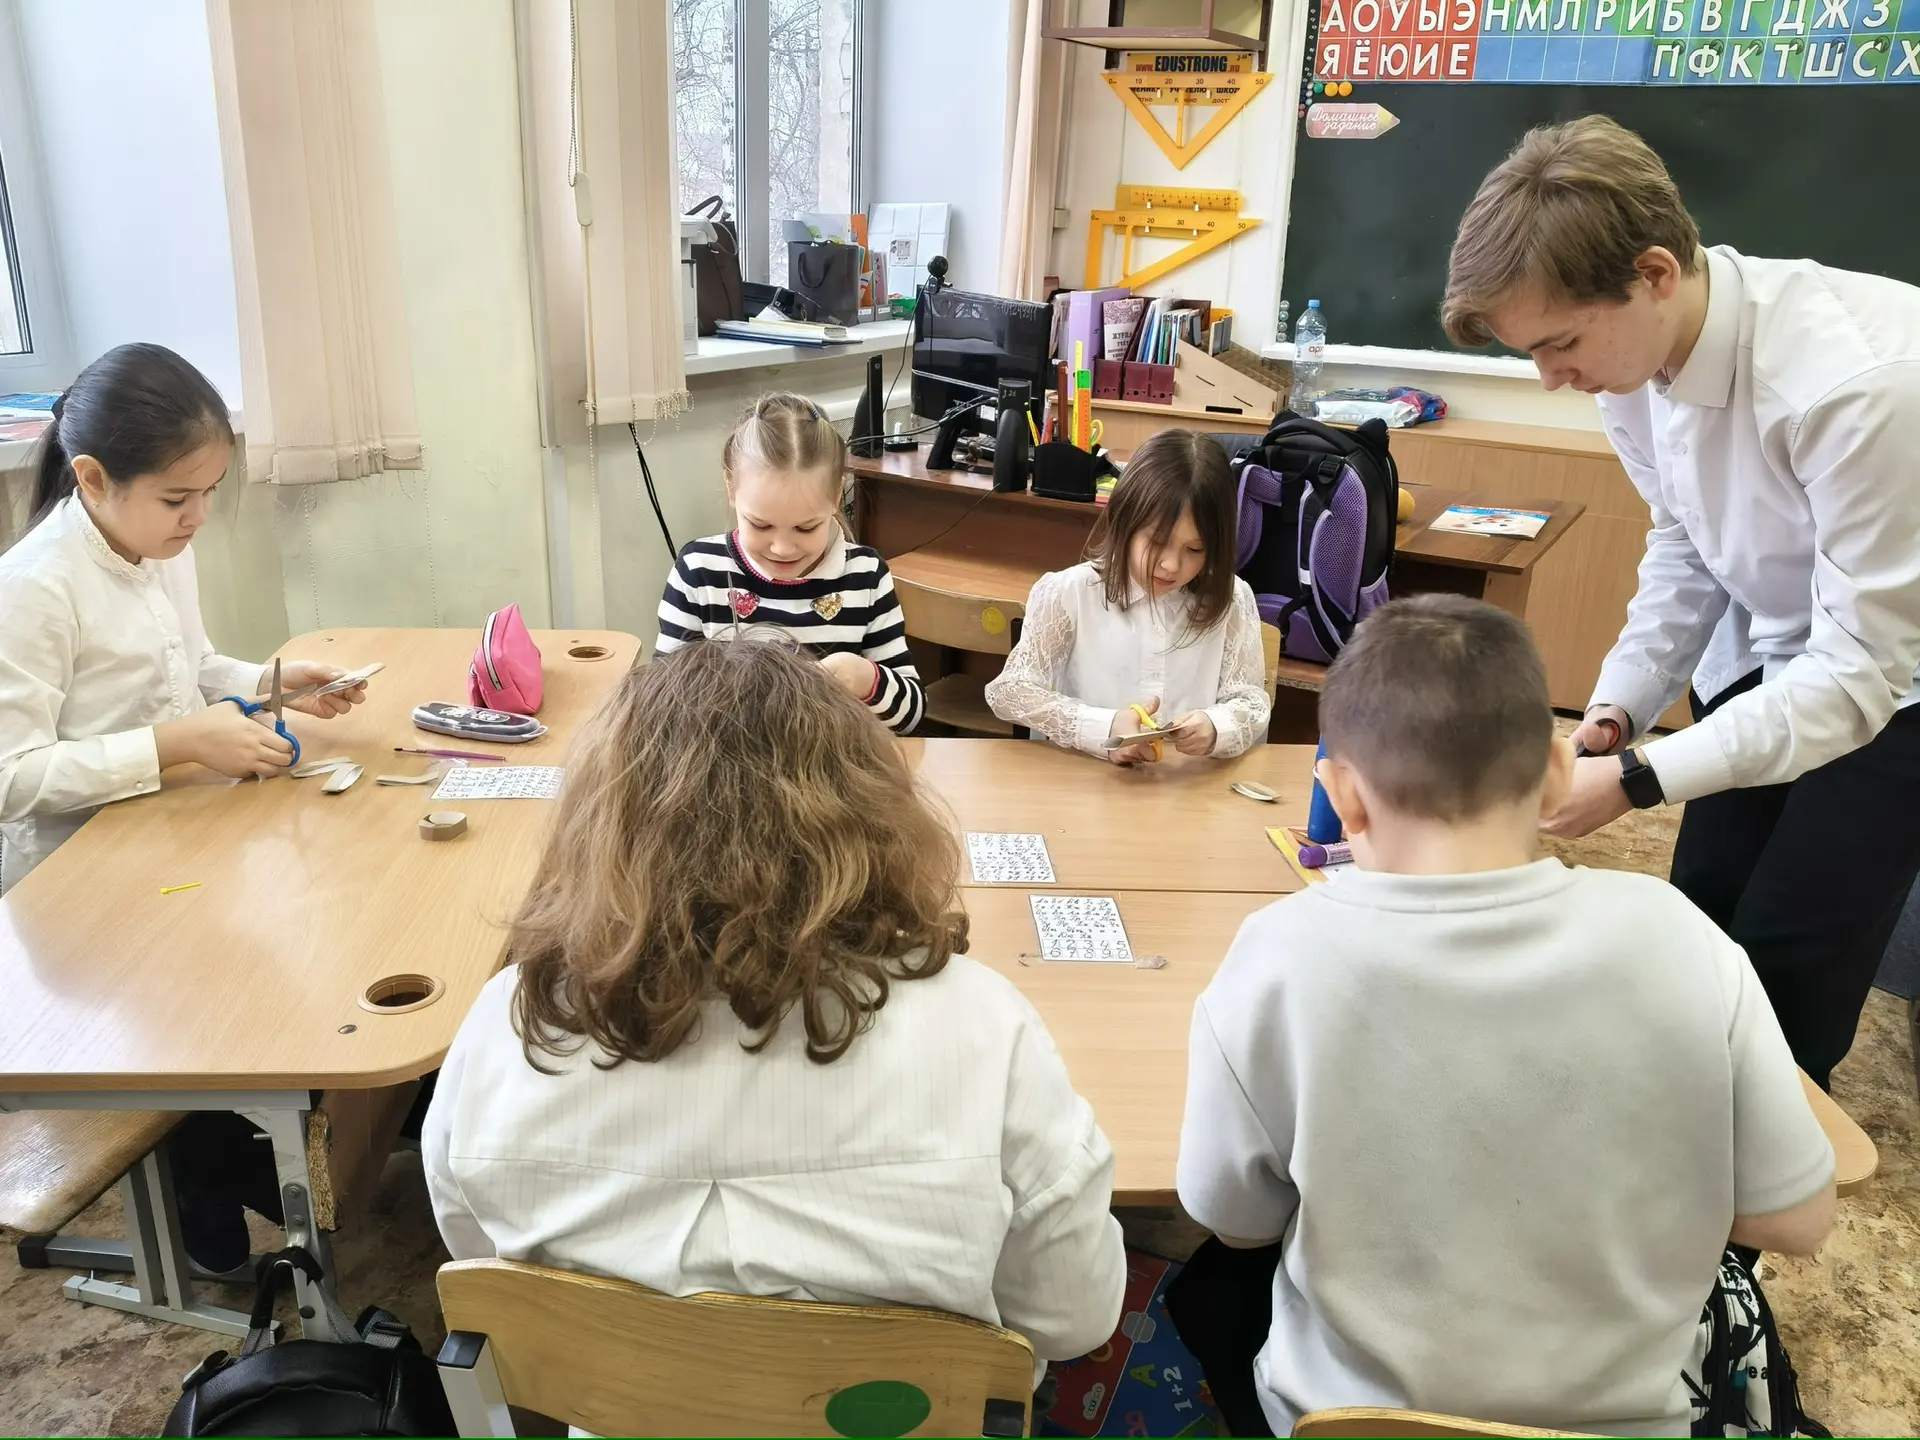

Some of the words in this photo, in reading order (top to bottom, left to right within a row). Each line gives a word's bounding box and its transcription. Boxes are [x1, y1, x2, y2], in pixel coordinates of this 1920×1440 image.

[1312, 106, 1379, 121] Домашнее
[1322, 121, 1377, 135] задание
[1118, 215, 1126, 223] 10
